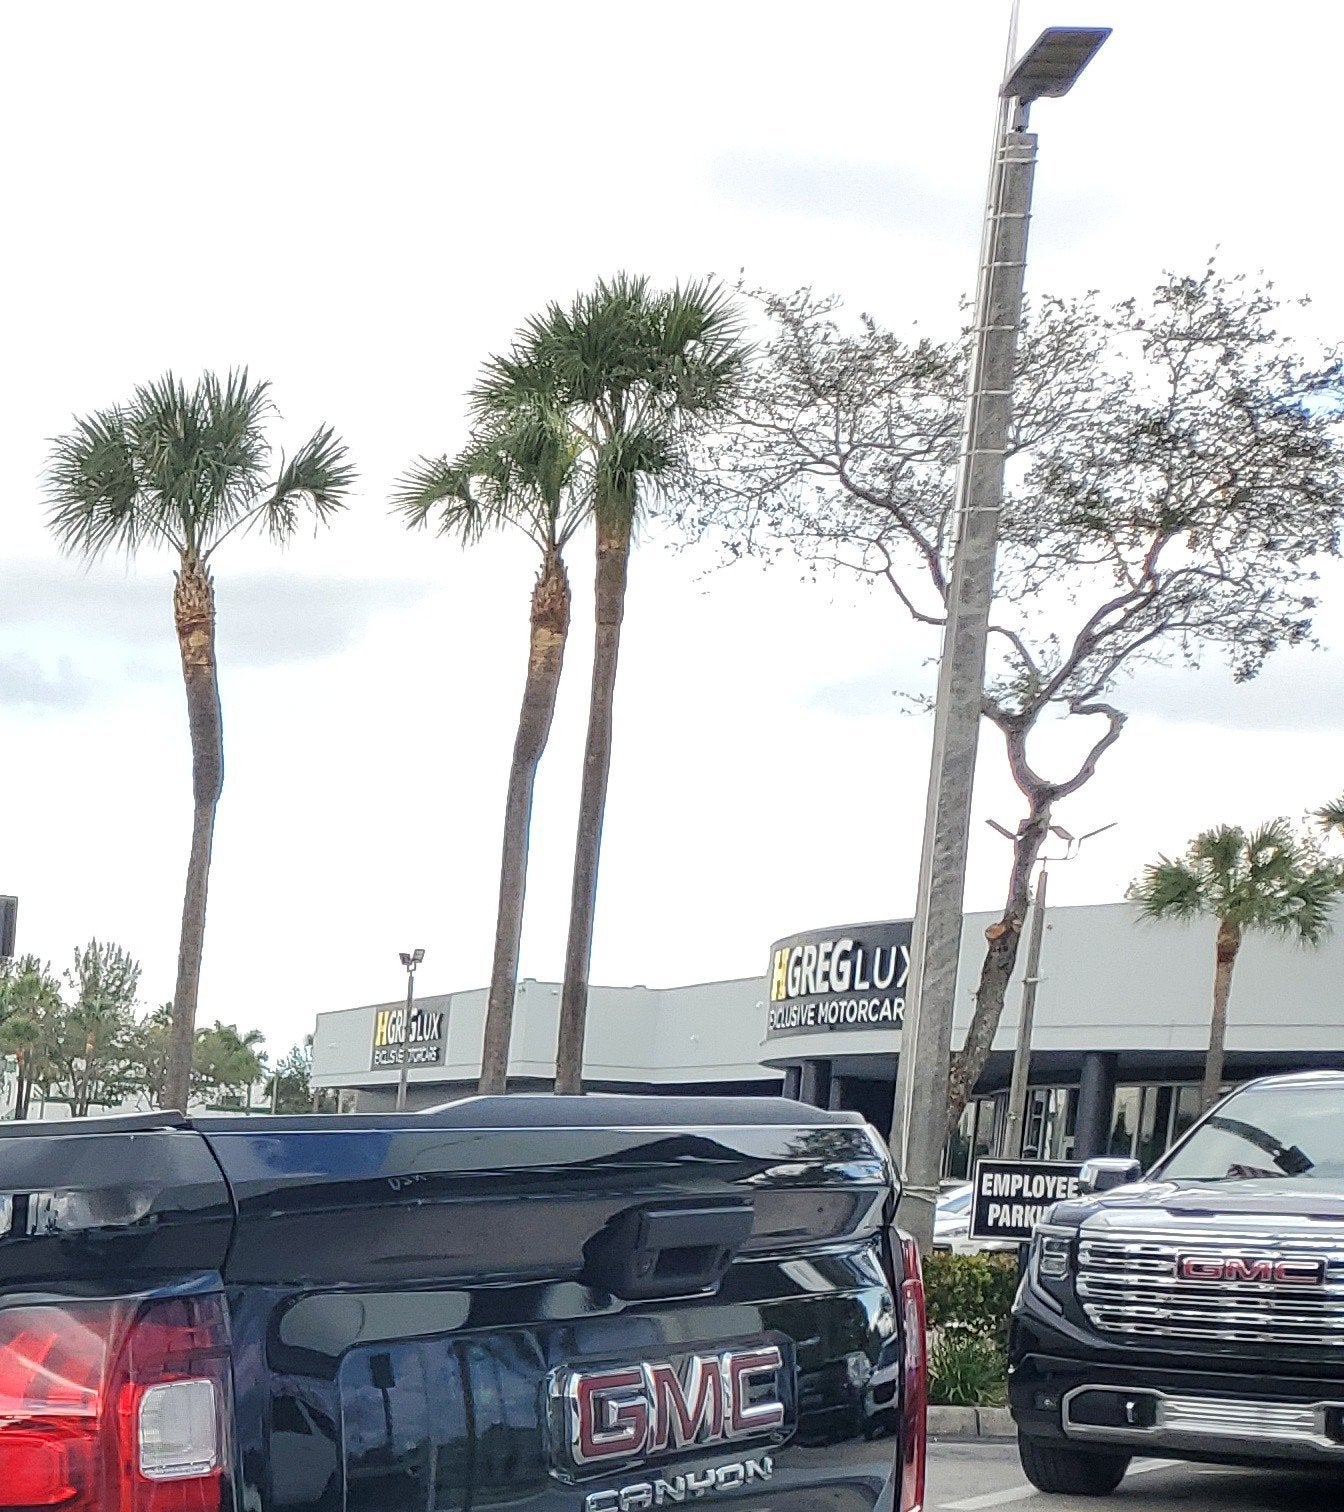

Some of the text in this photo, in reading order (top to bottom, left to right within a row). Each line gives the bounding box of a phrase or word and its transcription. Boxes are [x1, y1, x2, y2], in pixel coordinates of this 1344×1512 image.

[817, 997, 905, 1025] MOTORCAR
[981, 1173, 1080, 1199] EMPLOYEE
[1180, 1257, 1320, 1284] GMC
[570, 1345, 785, 1466] GMC
